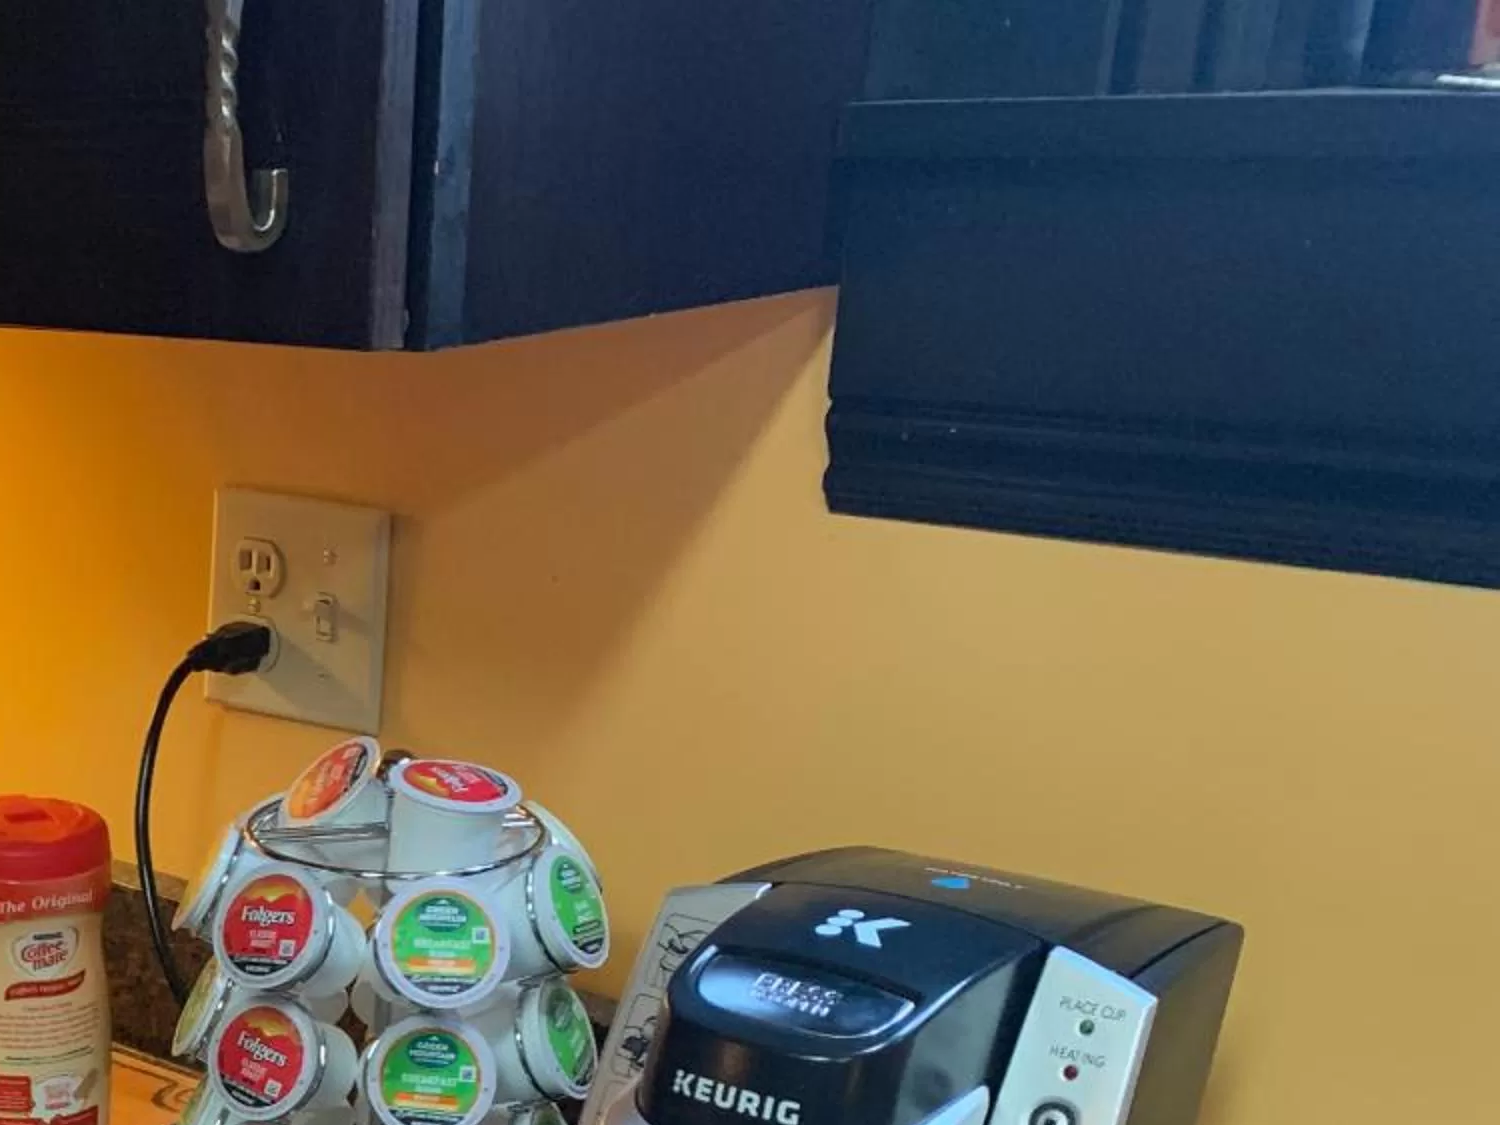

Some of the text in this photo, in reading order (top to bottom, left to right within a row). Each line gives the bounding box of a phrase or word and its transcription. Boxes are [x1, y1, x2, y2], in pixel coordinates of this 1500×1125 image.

[31, 889, 93, 911] Original
[241, 905, 296, 928] Folgers
[21, 941, 64, 963] Coffee
[33, 951, 68, 972] mate
[237, 1030, 288, 1067] Folgers
[1049, 1044, 1105, 1068] HEATING
